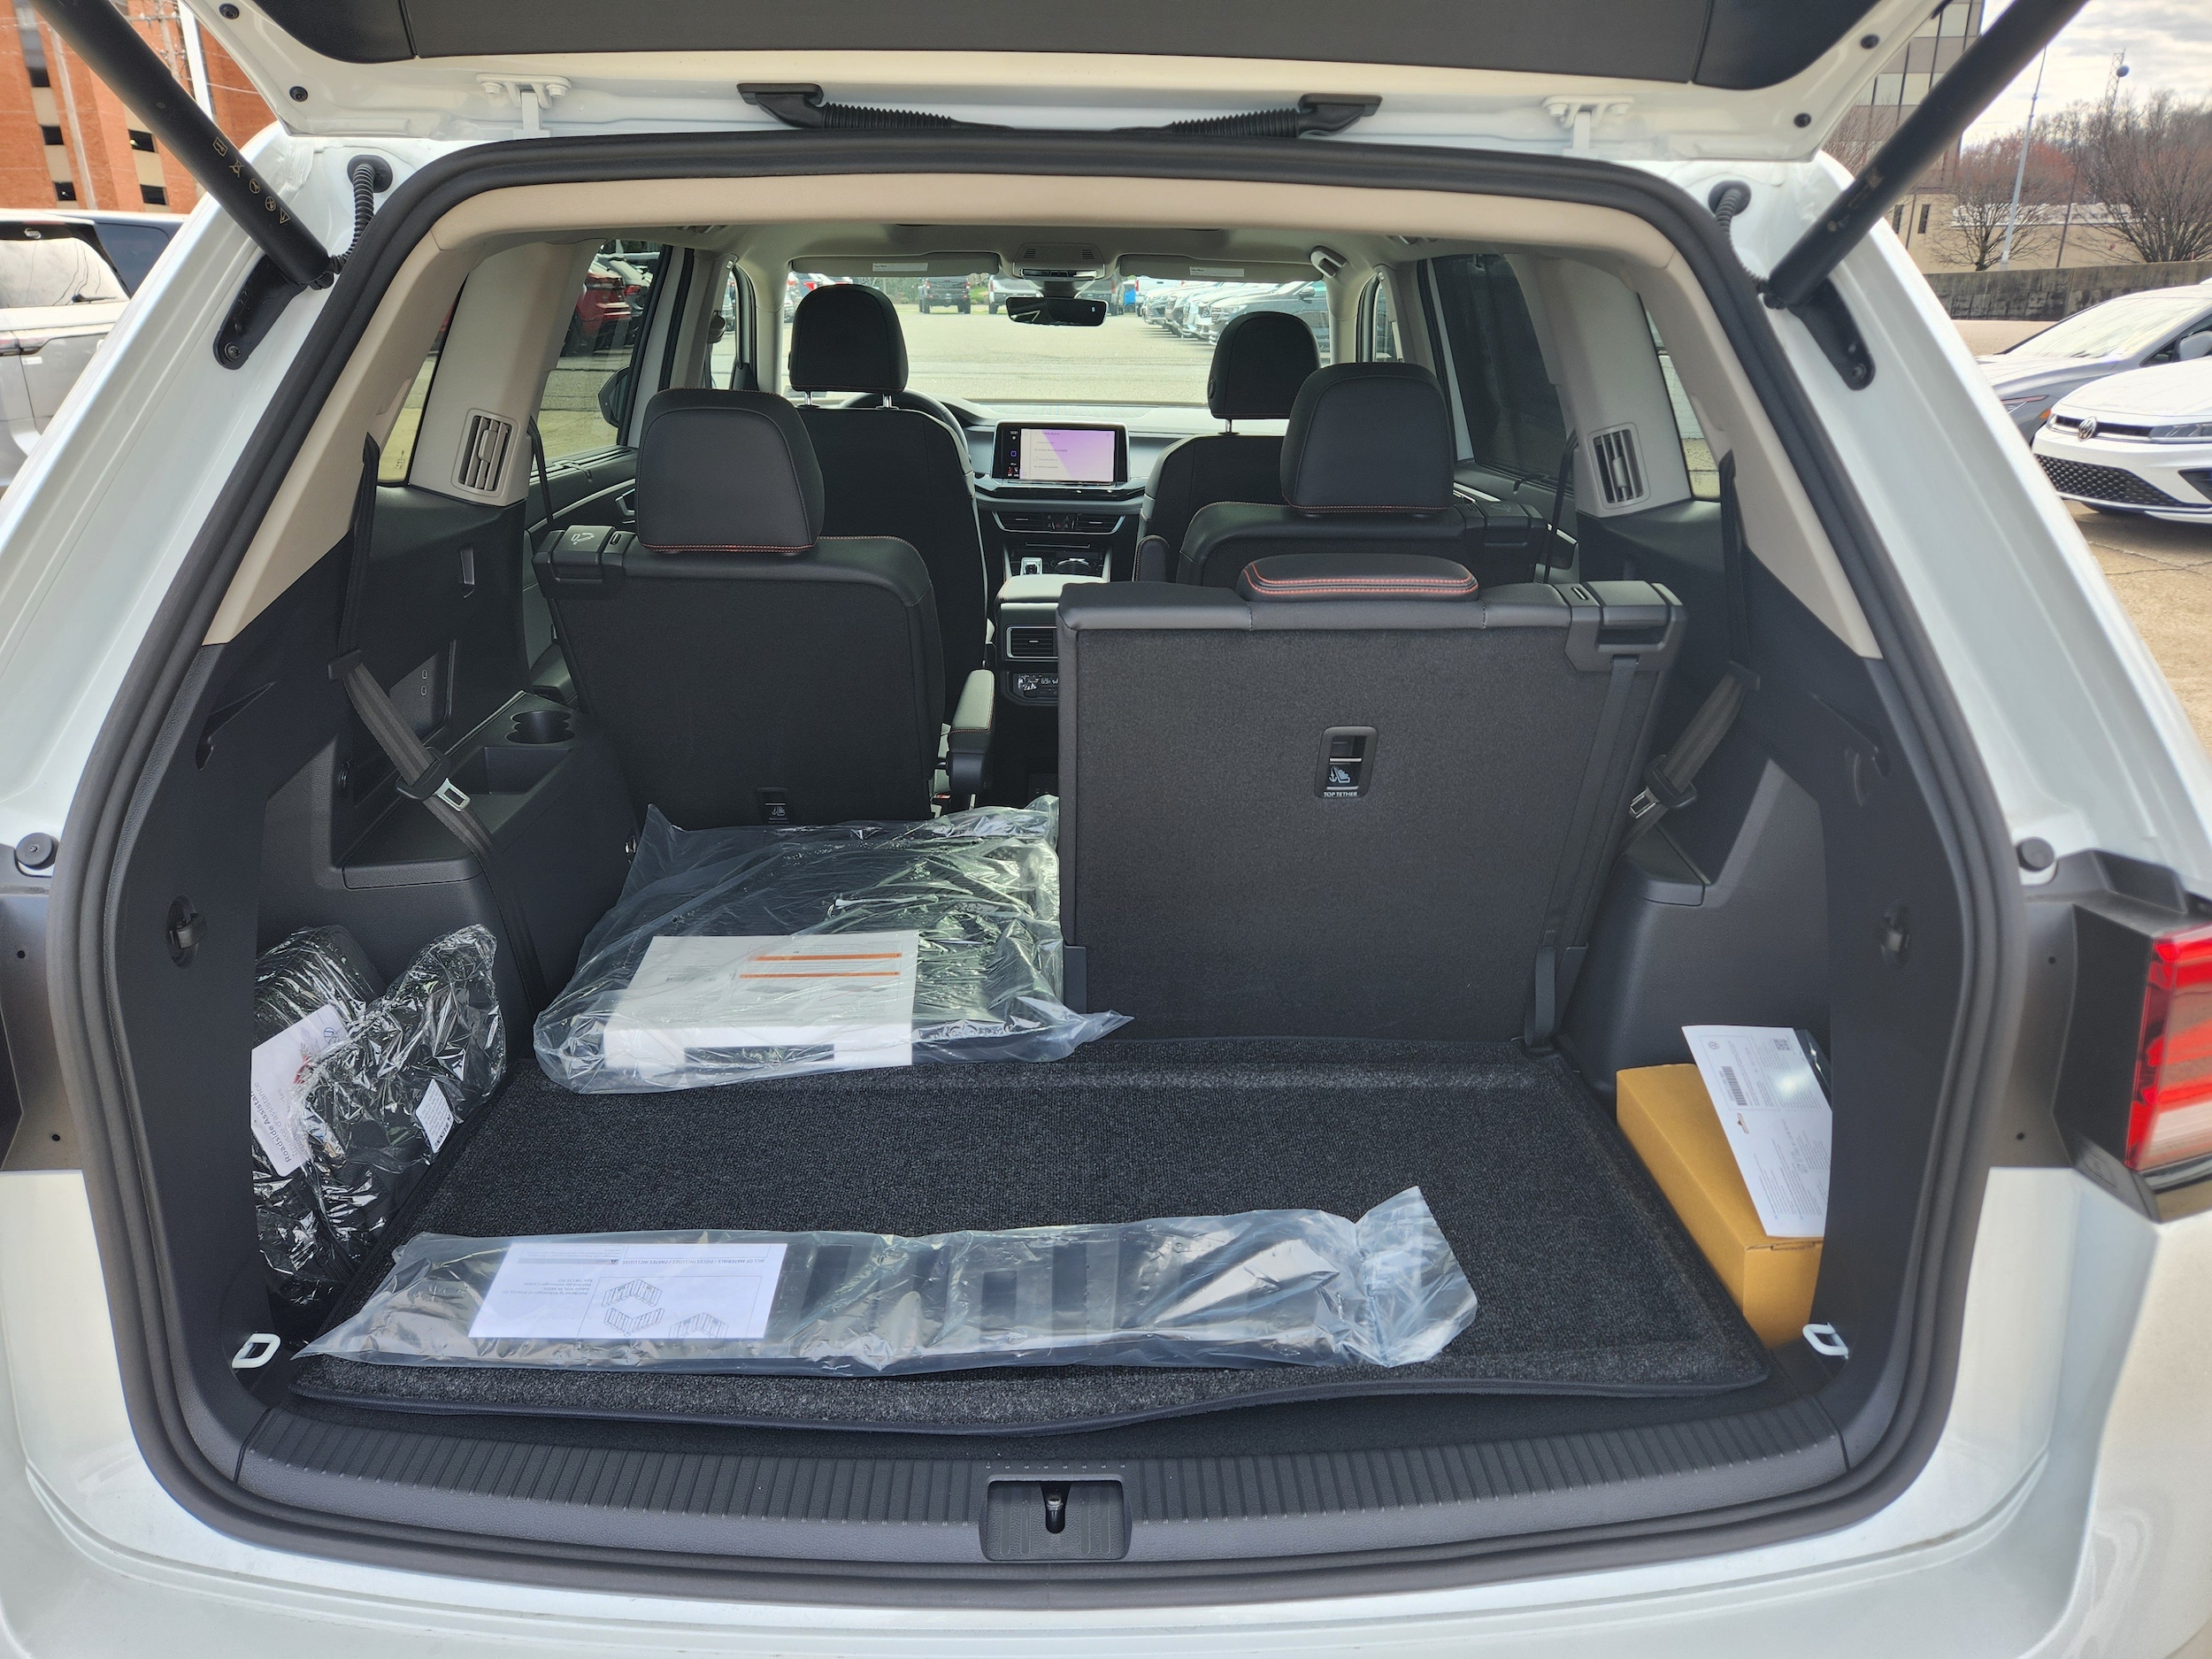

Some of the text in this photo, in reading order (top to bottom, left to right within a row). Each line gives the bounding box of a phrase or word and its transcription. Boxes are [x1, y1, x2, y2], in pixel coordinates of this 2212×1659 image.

[250, 1091, 271, 1125] Assistan
[253, 1081, 282, 1126] d'assistance
[267, 1124, 291, 1163] Roadside
